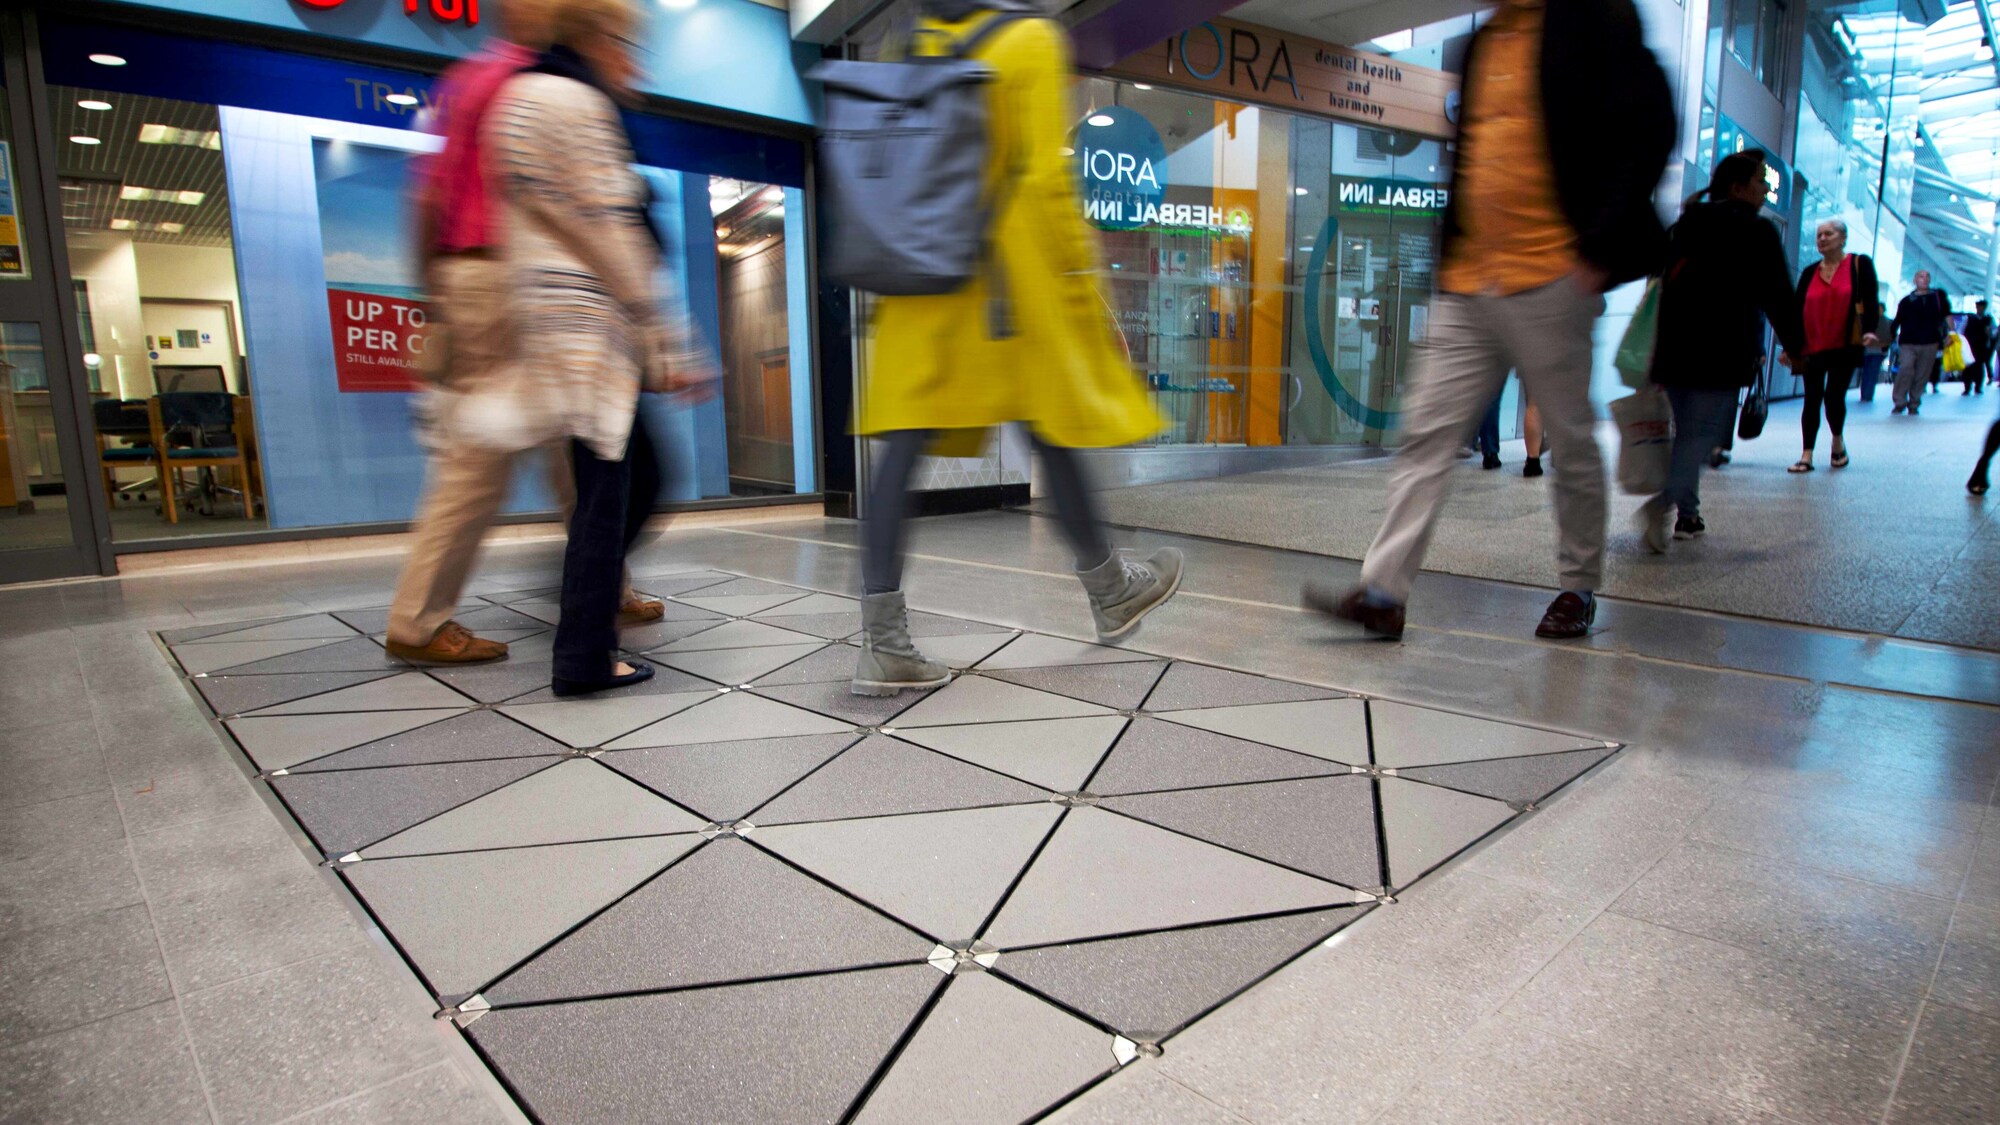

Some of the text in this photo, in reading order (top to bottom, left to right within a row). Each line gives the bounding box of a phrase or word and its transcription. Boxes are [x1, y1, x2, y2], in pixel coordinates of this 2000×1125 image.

[1315, 49, 1402, 82] dental health
[344, 77, 449, 121] TRAV
[1347, 81, 1370, 96] and
[1329, 92, 1385, 120] harmony
[1092, 184, 1148, 206] dental
[346, 299, 426, 329] UP TO
[347, 326, 399, 352] PER
[346, 353, 422, 369] STILL AVAILAB
